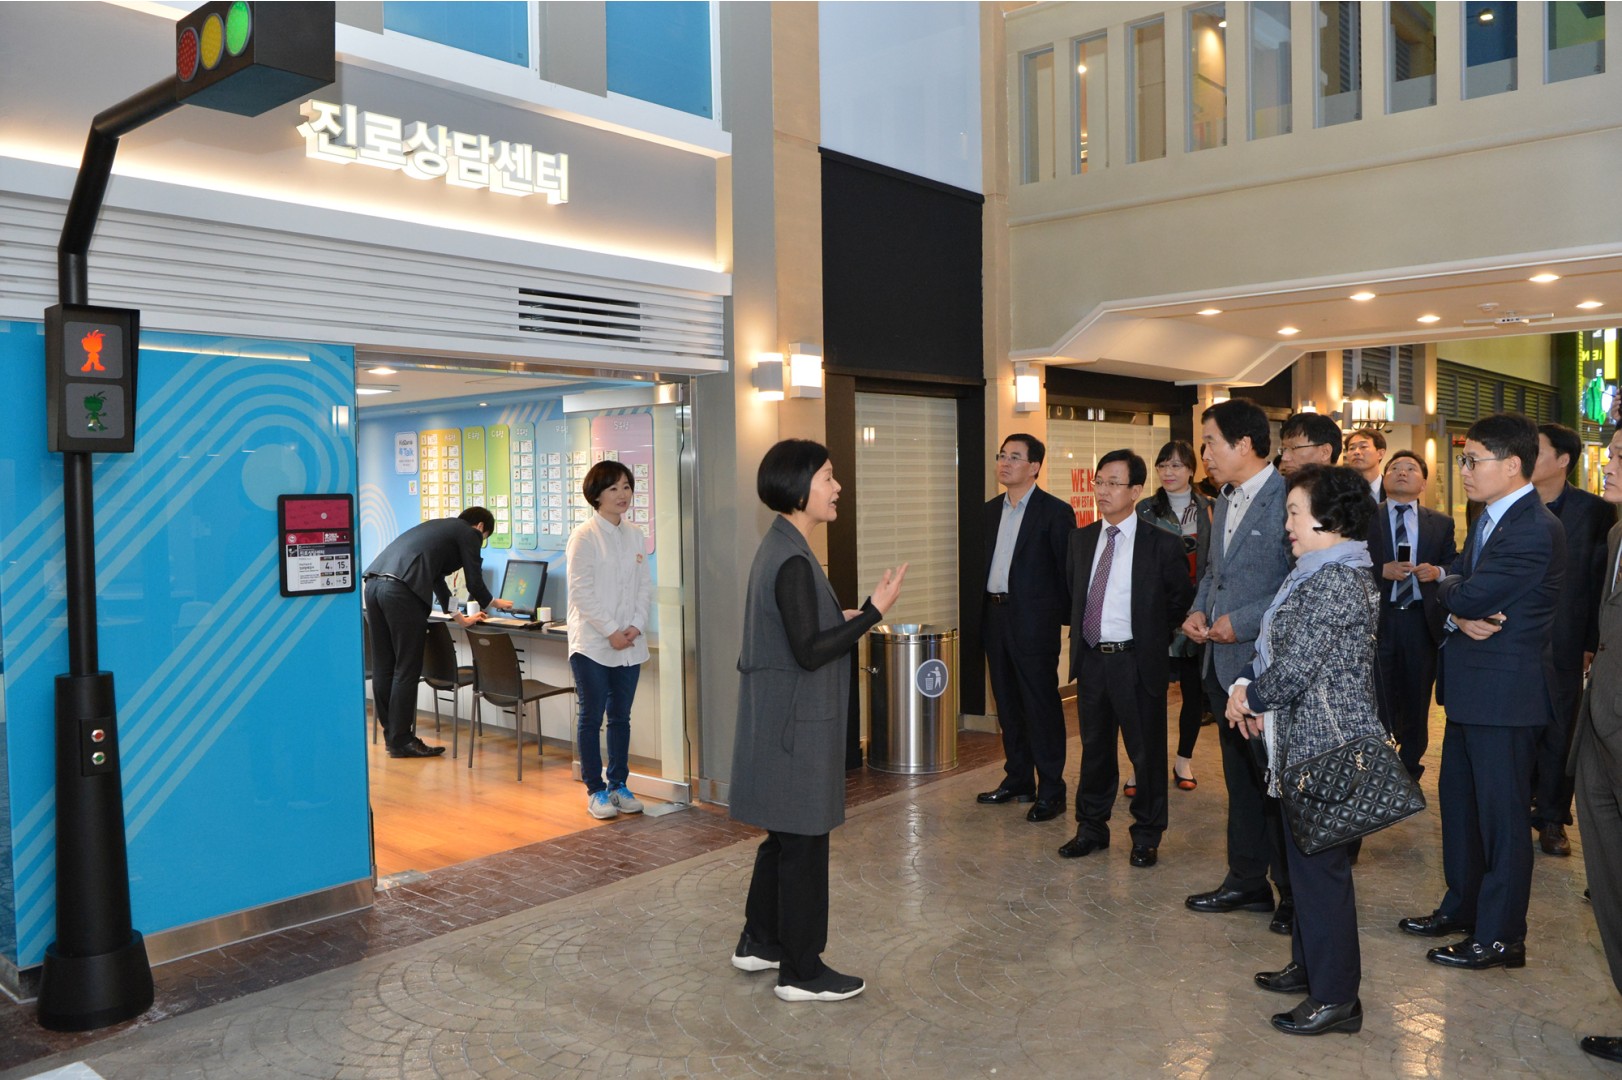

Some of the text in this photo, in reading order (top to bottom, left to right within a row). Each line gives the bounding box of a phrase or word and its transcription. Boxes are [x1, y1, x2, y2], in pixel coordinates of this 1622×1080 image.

[297, 99, 569, 204] 진로상담센터
[1071, 468, 1085, 492] WE
[337, 561, 345, 569] 15
[326, 578, 331, 586] 6
[342, 576, 347, 584] 5
